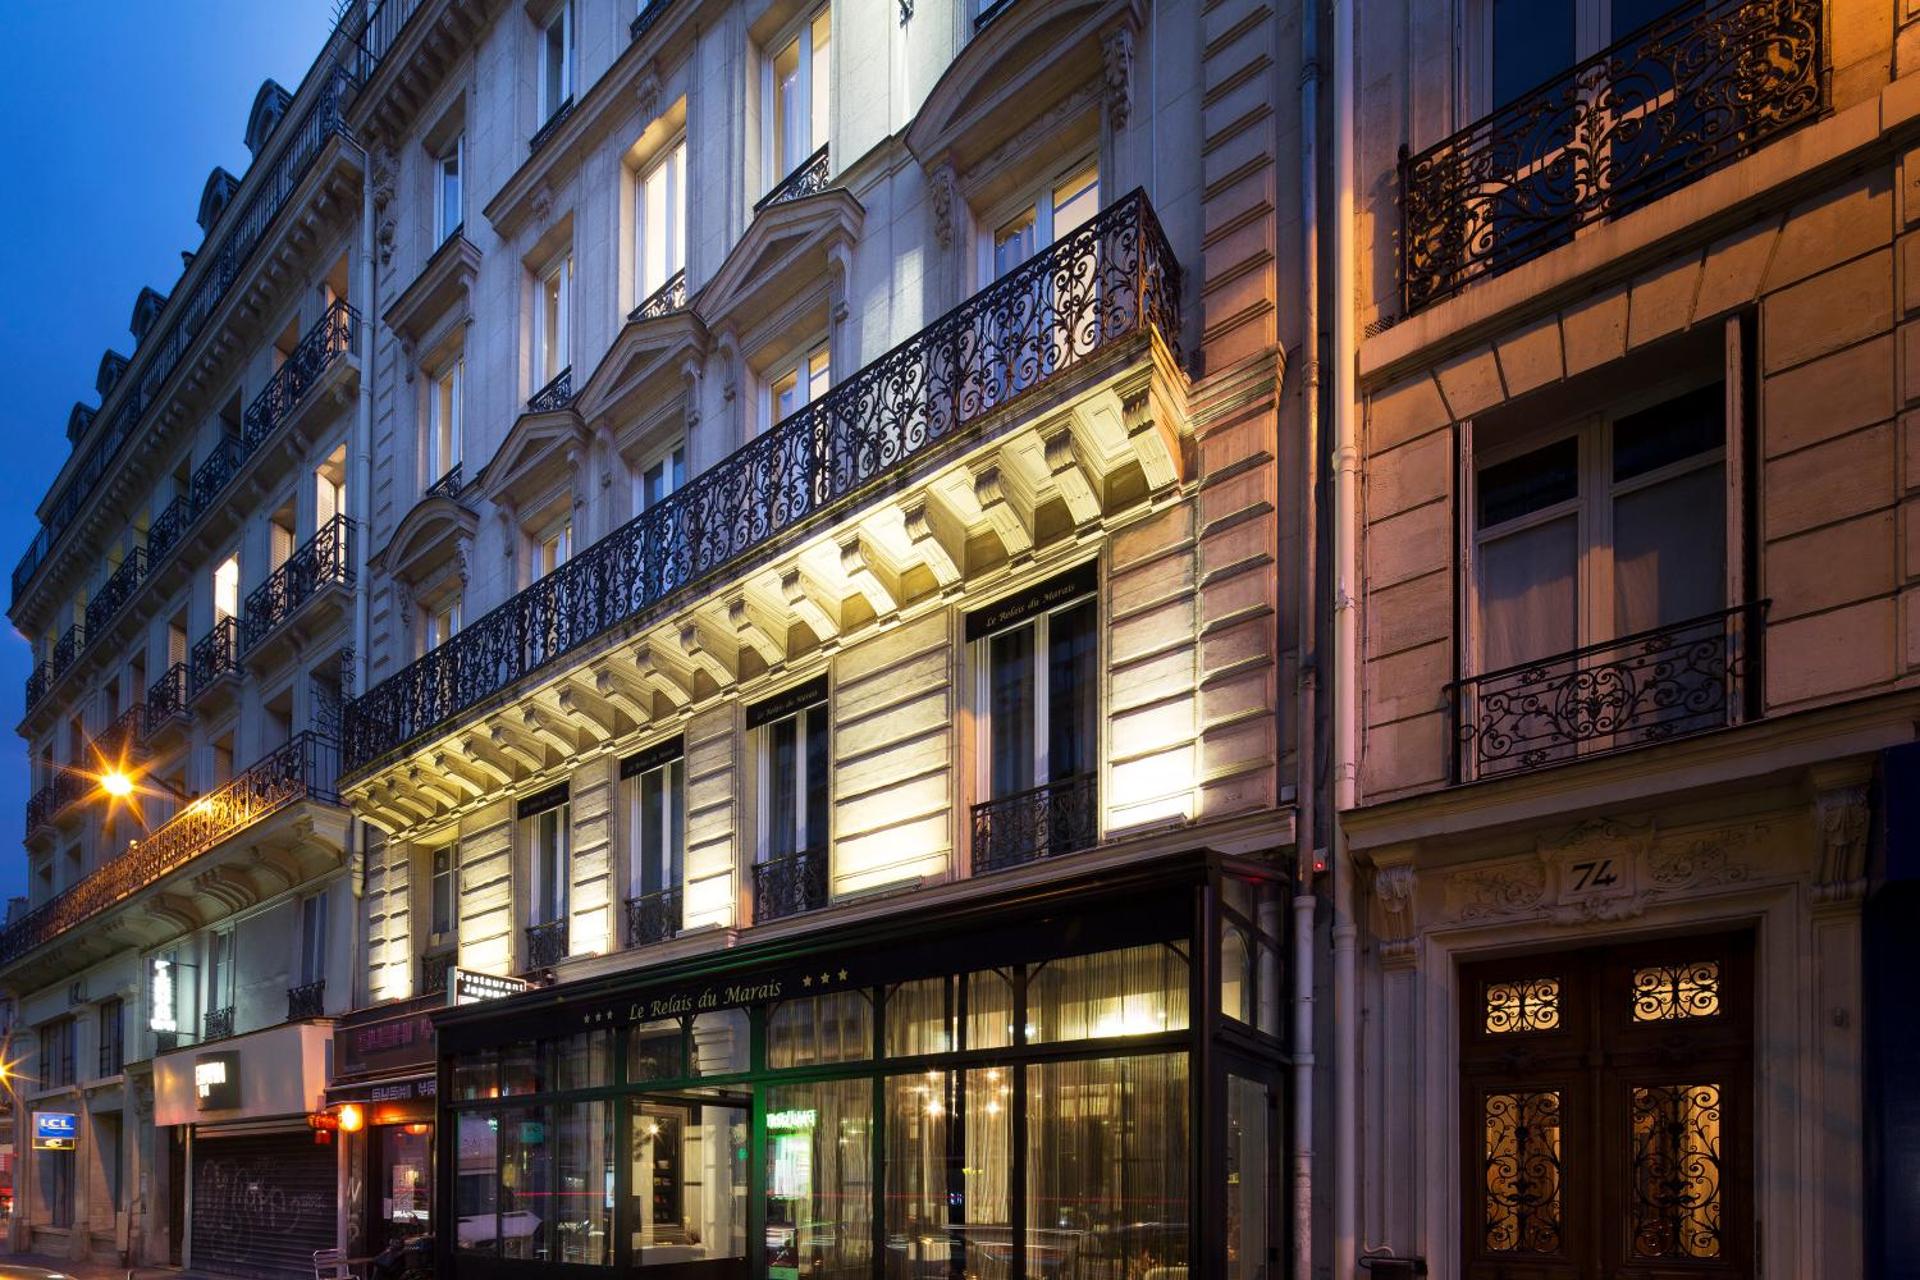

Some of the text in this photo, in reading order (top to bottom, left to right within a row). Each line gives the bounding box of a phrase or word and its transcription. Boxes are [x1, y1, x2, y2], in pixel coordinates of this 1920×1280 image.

[1572, 860, 1617, 891] 74
[457, 971, 523, 992] Restaurant
[630, 979, 782, 1020] Le Relais du Marais
[372, 1085, 412, 1100] SUSHI
[40, 1118, 72, 1129] LCL
